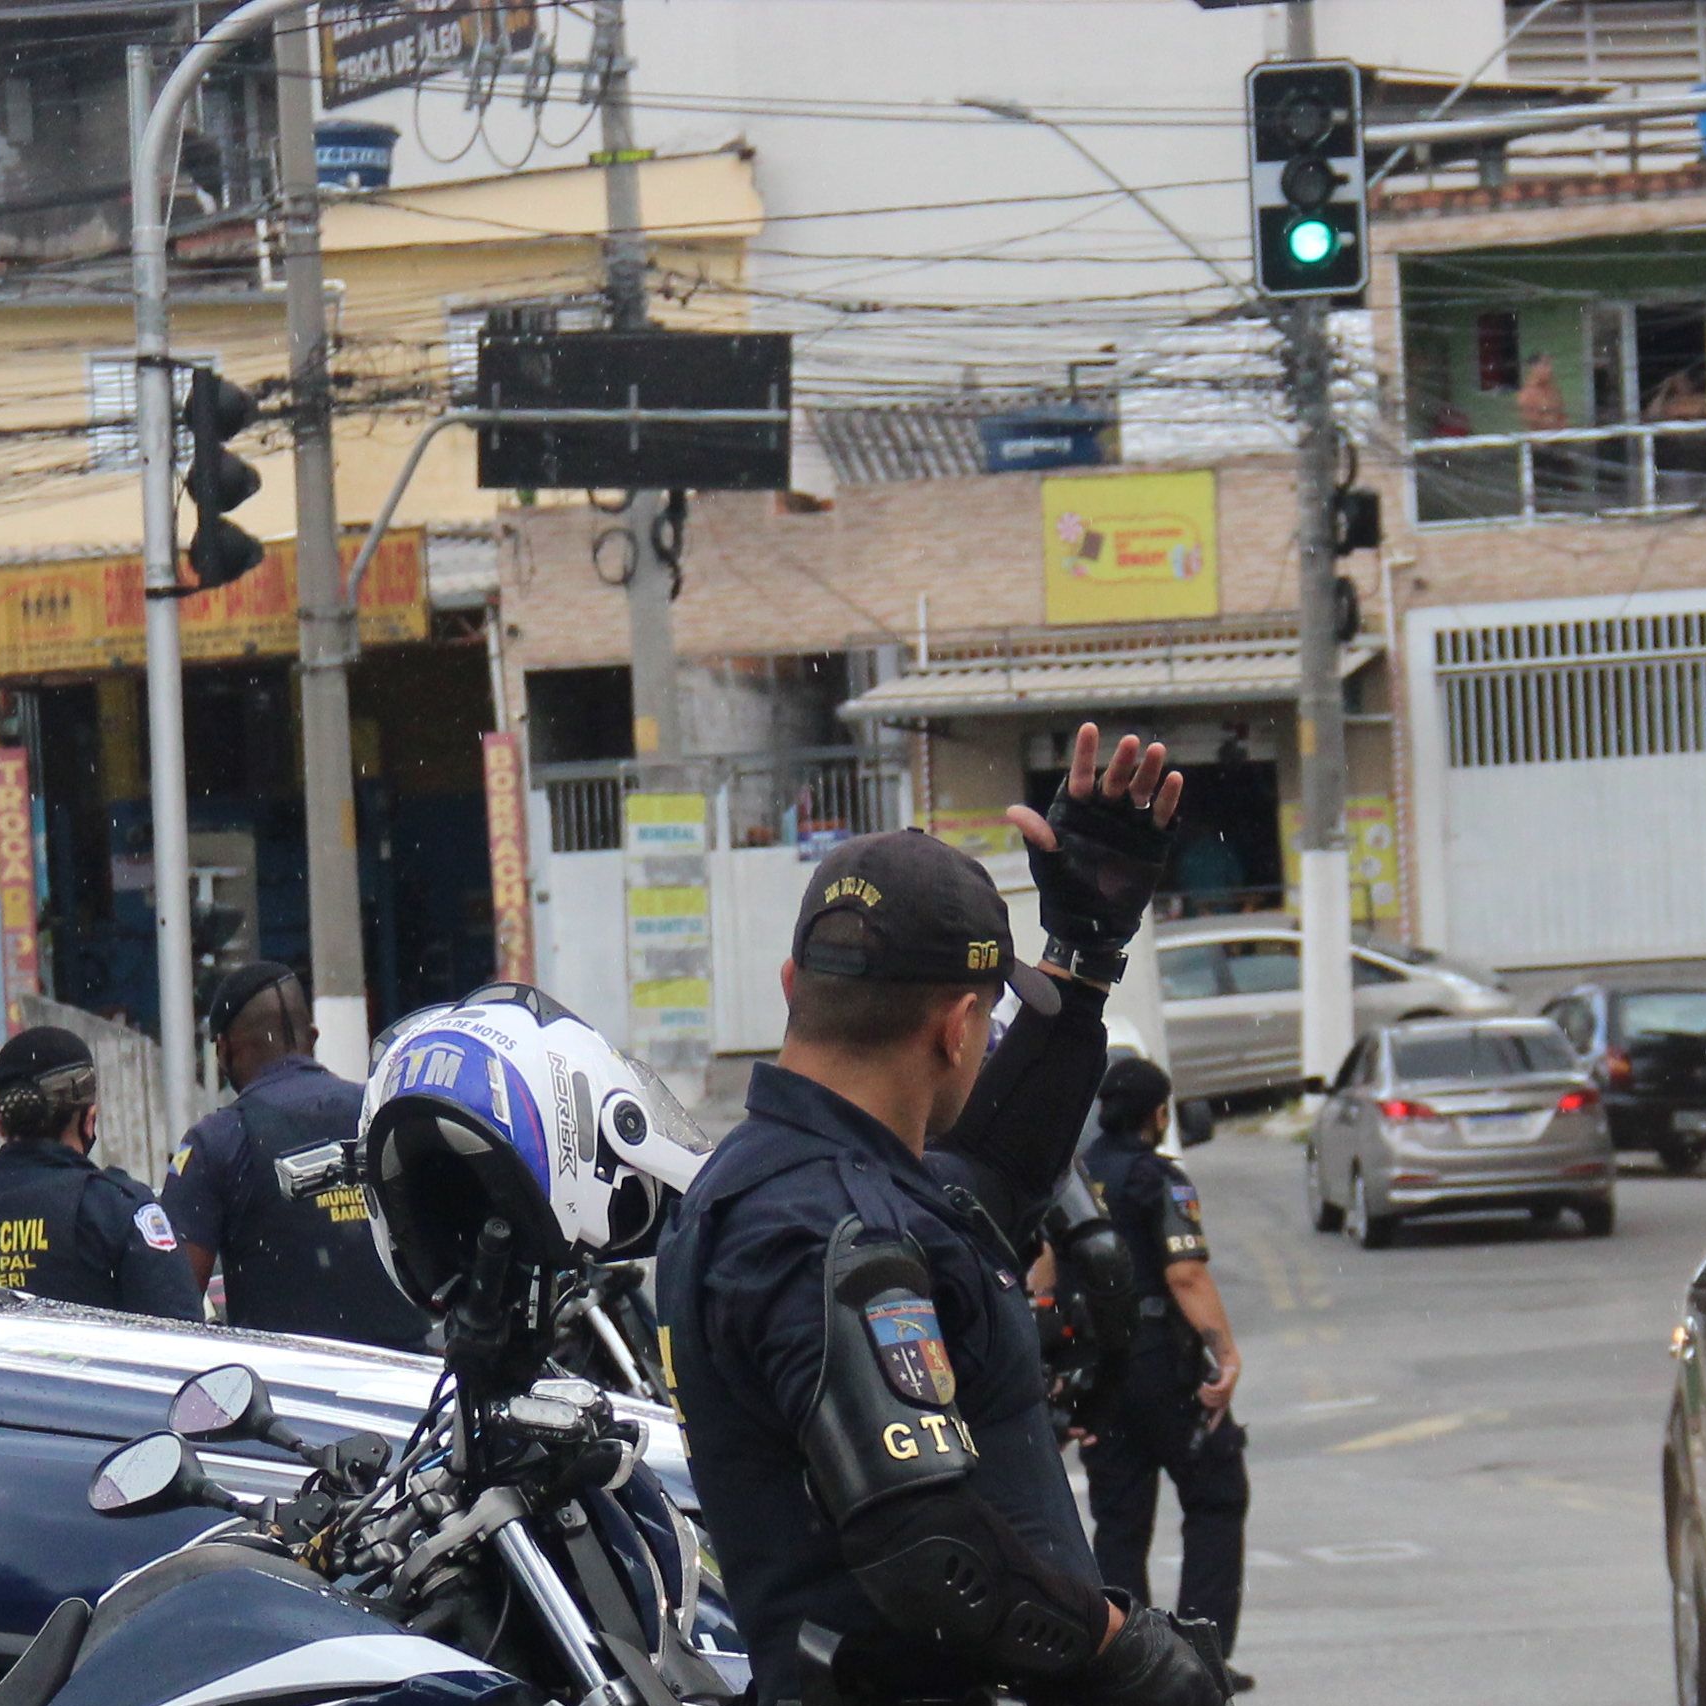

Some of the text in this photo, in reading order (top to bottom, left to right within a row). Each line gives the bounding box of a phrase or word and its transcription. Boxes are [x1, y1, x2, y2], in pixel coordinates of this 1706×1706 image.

[394, 34, 417, 76] DE
[469, 1022, 518, 1051] MOTOS
[0, 1208, 49, 1252] CIVIL
[1167, 1234, 1206, 1254] RO
